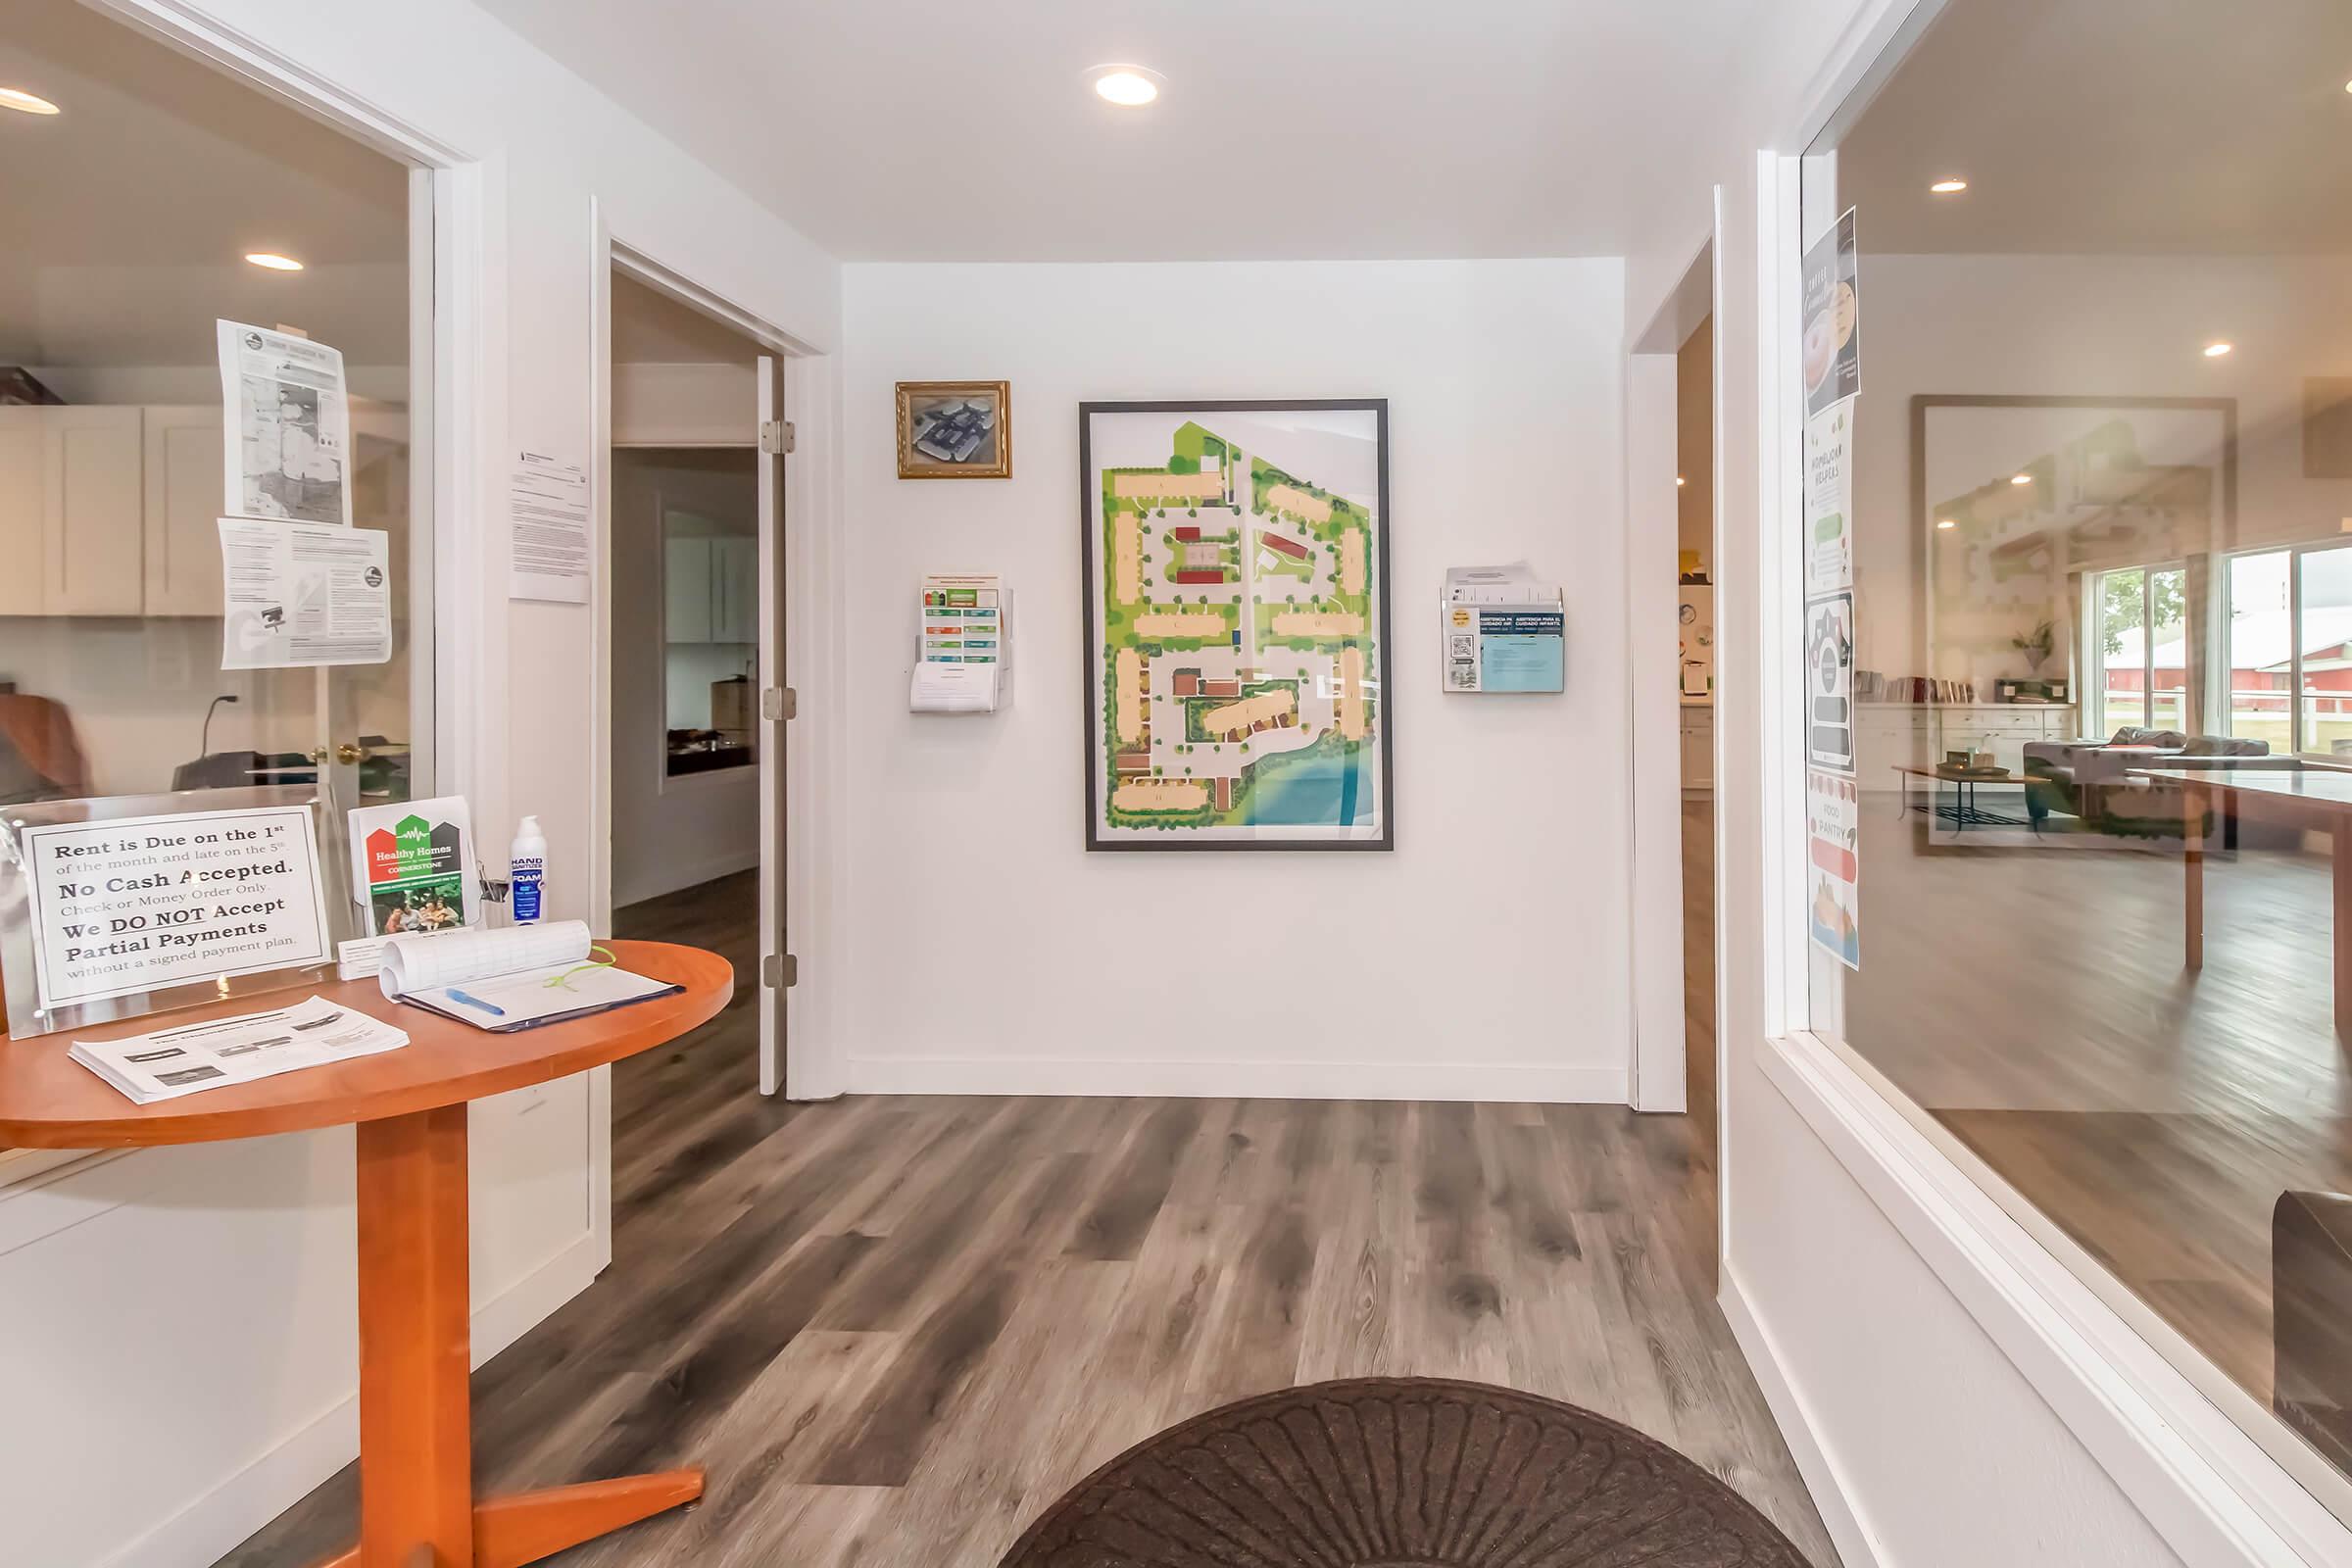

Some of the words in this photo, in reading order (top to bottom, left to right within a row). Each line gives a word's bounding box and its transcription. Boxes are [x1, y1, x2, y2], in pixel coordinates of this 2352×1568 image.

[1824, 804, 1839, 817] FOOD
[55, 843, 110, 858] Rent
[120, 840, 137, 851] is
[145, 836, 186, 849] Due
[194, 833, 219, 844] on
[225, 829, 257, 841] the
[265, 825, 284, 838] 1st
[1819, 820, 1845, 840] PANTRY
[56, 864, 72, 875] of
[77, 862, 102, 872] the
[108, 855, 157, 869] month
[162, 852, 190, 863] and
[196, 850, 220, 859] late
[224, 848, 241, 857] on
[245, 845, 266, 855] the
[376, 849, 415, 861] Healthy
[416, 846, 451, 856] Homes
[388, 861, 443, 874] CORNERSTONE
[59, 883, 95, 899] No
[106, 873, 171, 892] Cash
[180, 860, 293, 884] Accepted.
[61, 902, 112, 916] Check
[117, 901, 133, 909] or
[139, 893, 187, 906] Money
[192, 888, 232, 899] Order
[63, 924, 100, 939] We
[109, 916, 147, 932] DO
[156, 907, 205, 926] NOT
[214, 899, 285, 917] Accept
[65, 937, 150, 962] Partial
[159, 923, 267, 947] Payments
[67, 962, 129, 979] without
[149, 950, 196, 965] signed
[202, 942, 261, 959] payment
